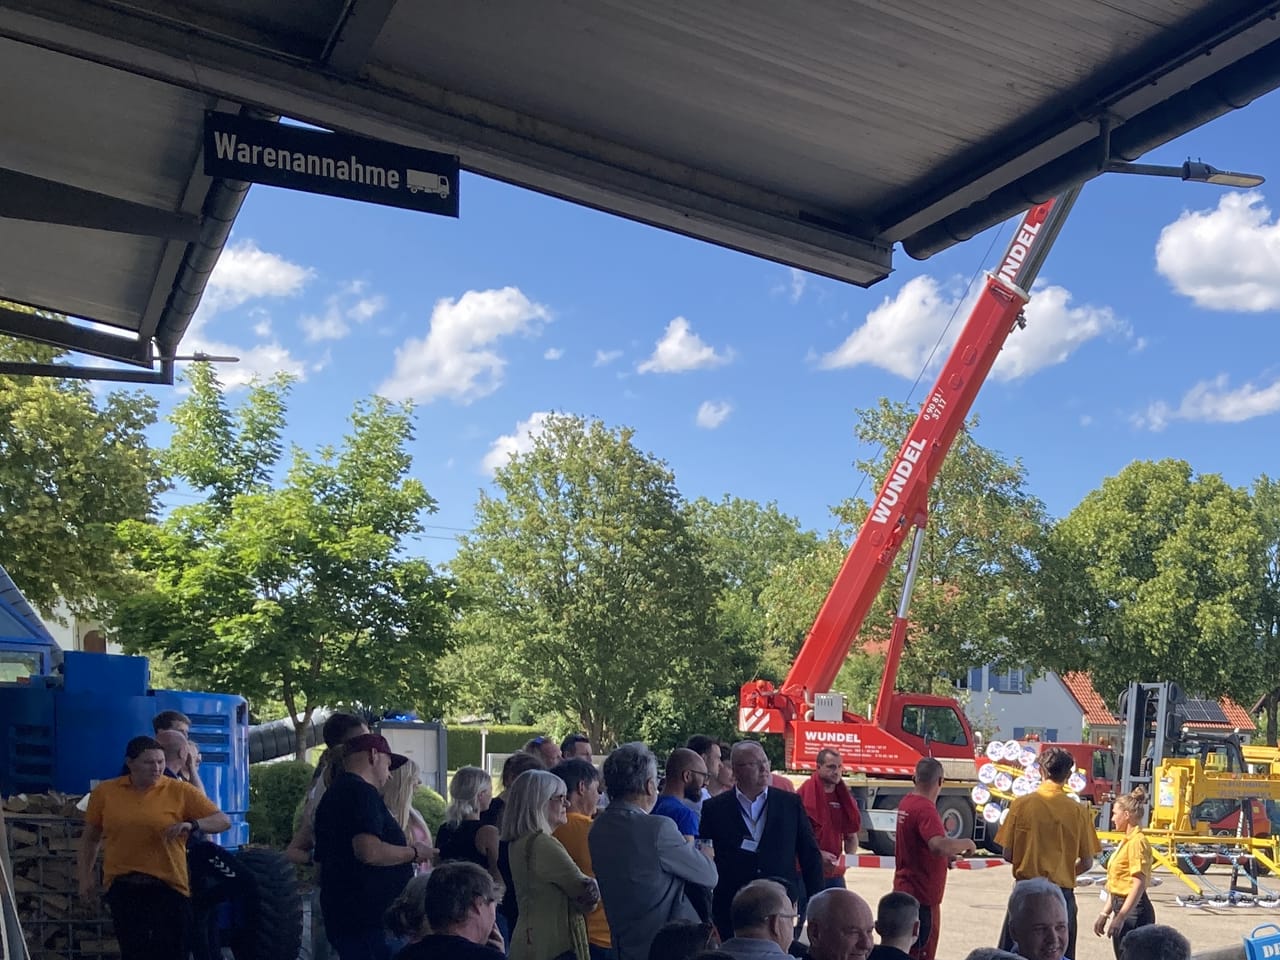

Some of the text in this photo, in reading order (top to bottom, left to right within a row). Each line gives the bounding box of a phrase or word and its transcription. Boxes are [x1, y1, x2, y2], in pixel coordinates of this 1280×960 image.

[214, 131, 400, 189] Warenannahme
[998, 222, 1041, 286] NDEL
[871, 438, 928, 524] WUNDEL
[805, 731, 861, 743] WUNDEL
